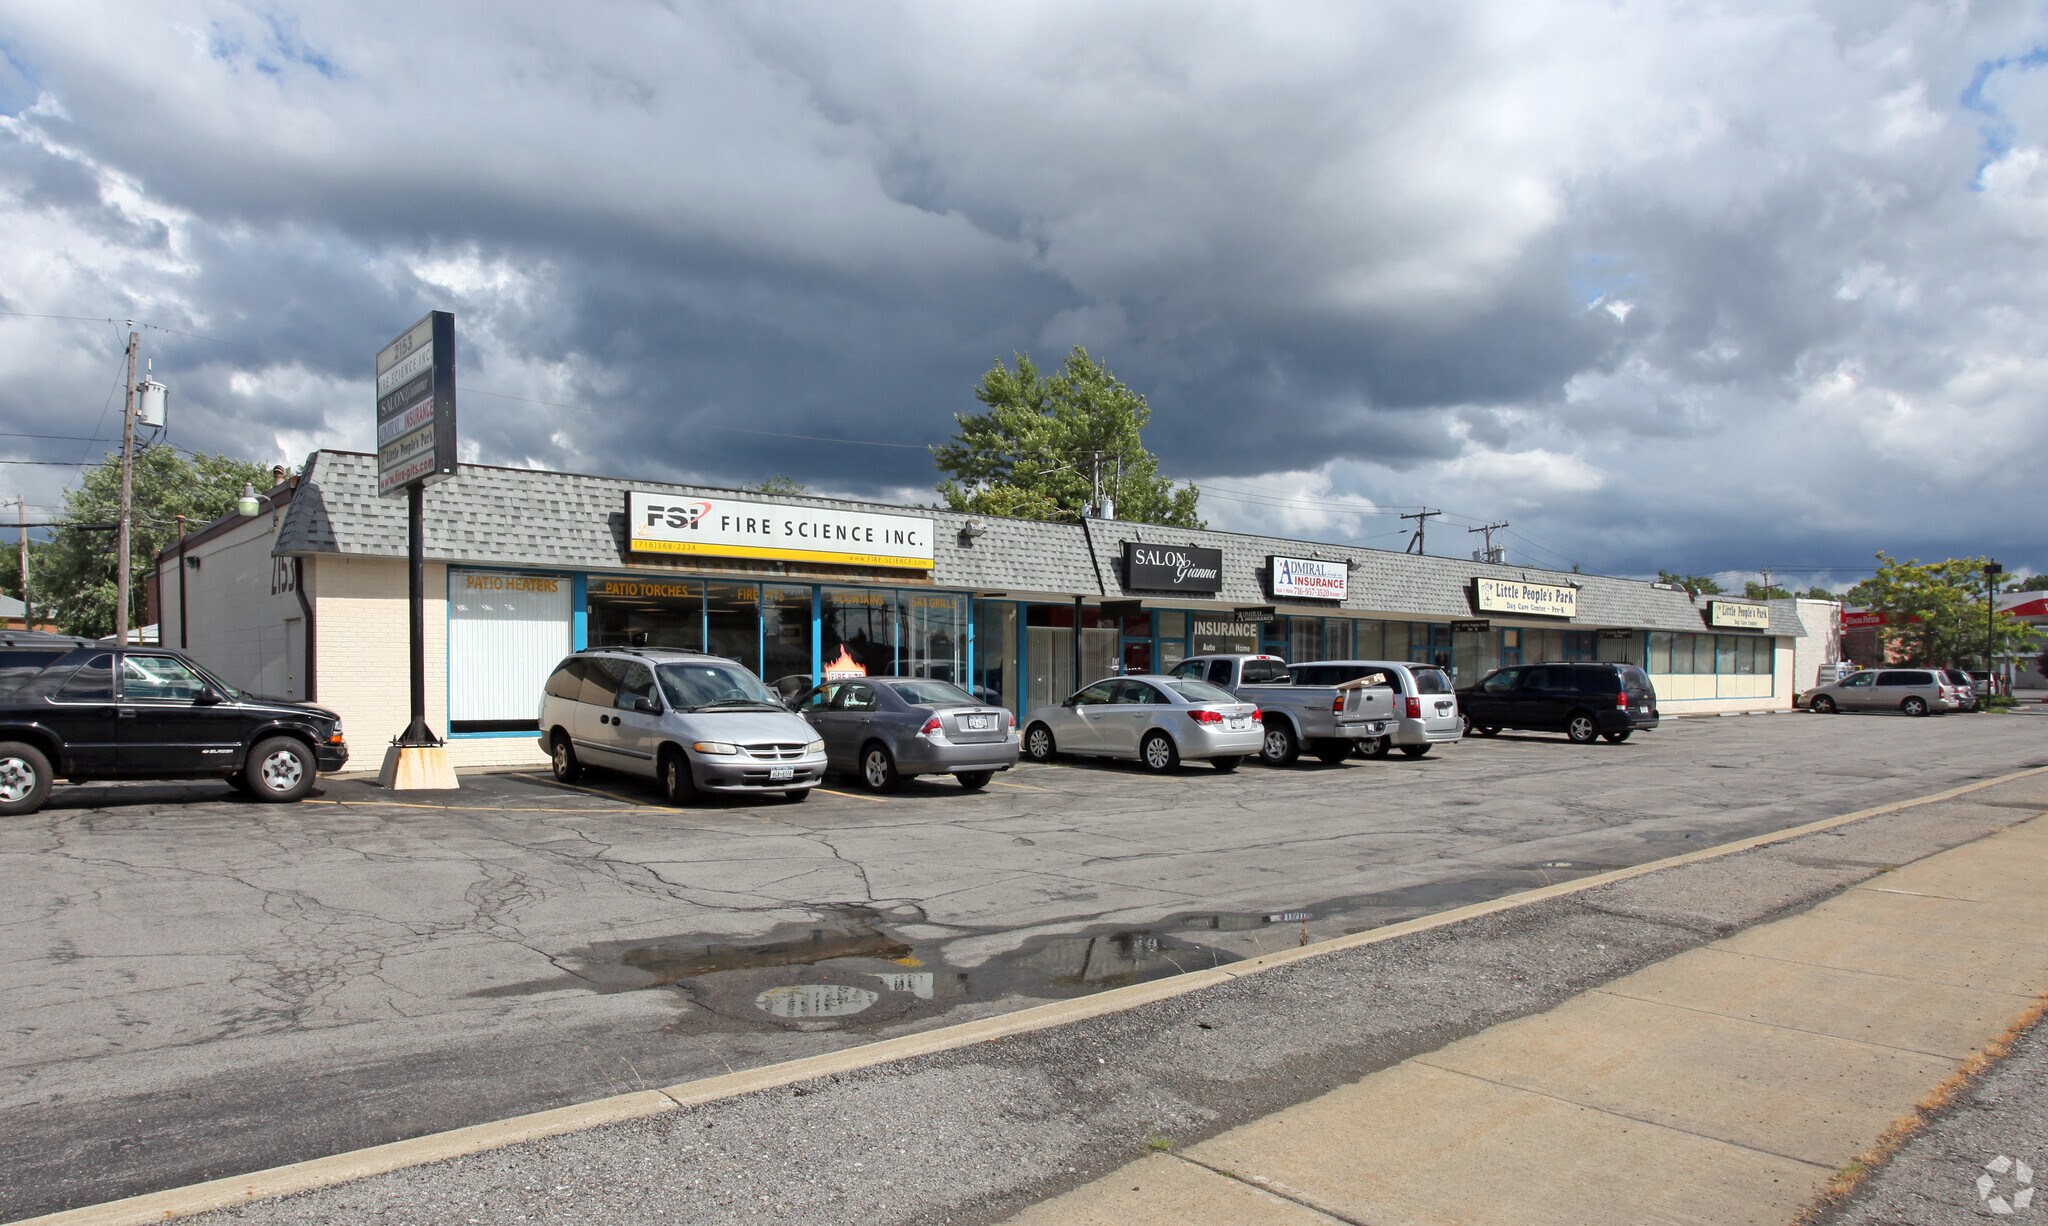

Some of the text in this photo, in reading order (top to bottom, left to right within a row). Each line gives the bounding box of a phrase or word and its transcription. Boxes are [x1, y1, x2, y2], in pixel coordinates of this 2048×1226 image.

[394, 334, 413, 360] 2153
[391, 358, 416, 384] SCIENCE
[381, 390, 406, 416] SALON
[404, 400, 433, 430] INSURANCE
[386, 430, 433, 463] Little People's Park
[380, 458, 433, 489] www.fire-pits.com
[721, 516, 923, 546] FIRE SCIENCE INC.
[634, 541, 696, 551] (716)568-2224
[1135, 549, 1186, 567] SALON
[1173, 560, 1217, 583] Gianna
[1279, 560, 1326, 584] ADMIRAL
[466, 576, 559, 592] PATIO HEATERS
[605, 582, 689, 597] PATIO TORCHES
[1294, 576, 1344, 589] INSURANCE
[737, 588, 757, 600] FIRE
[1495, 583, 1573, 604] Little People's Park
[1506, 602, 1515, 610] Day
[1530, 604, 1545, 612] Center
[1722, 605, 1767, 619] Little People's Park
[1236, 611, 1262, 622] ADMIRAL
[1194, 621, 1257, 637] INSURANCE
[1203, 643, 1216, 651] Auto
[1235, 644, 1251, 652] Home
